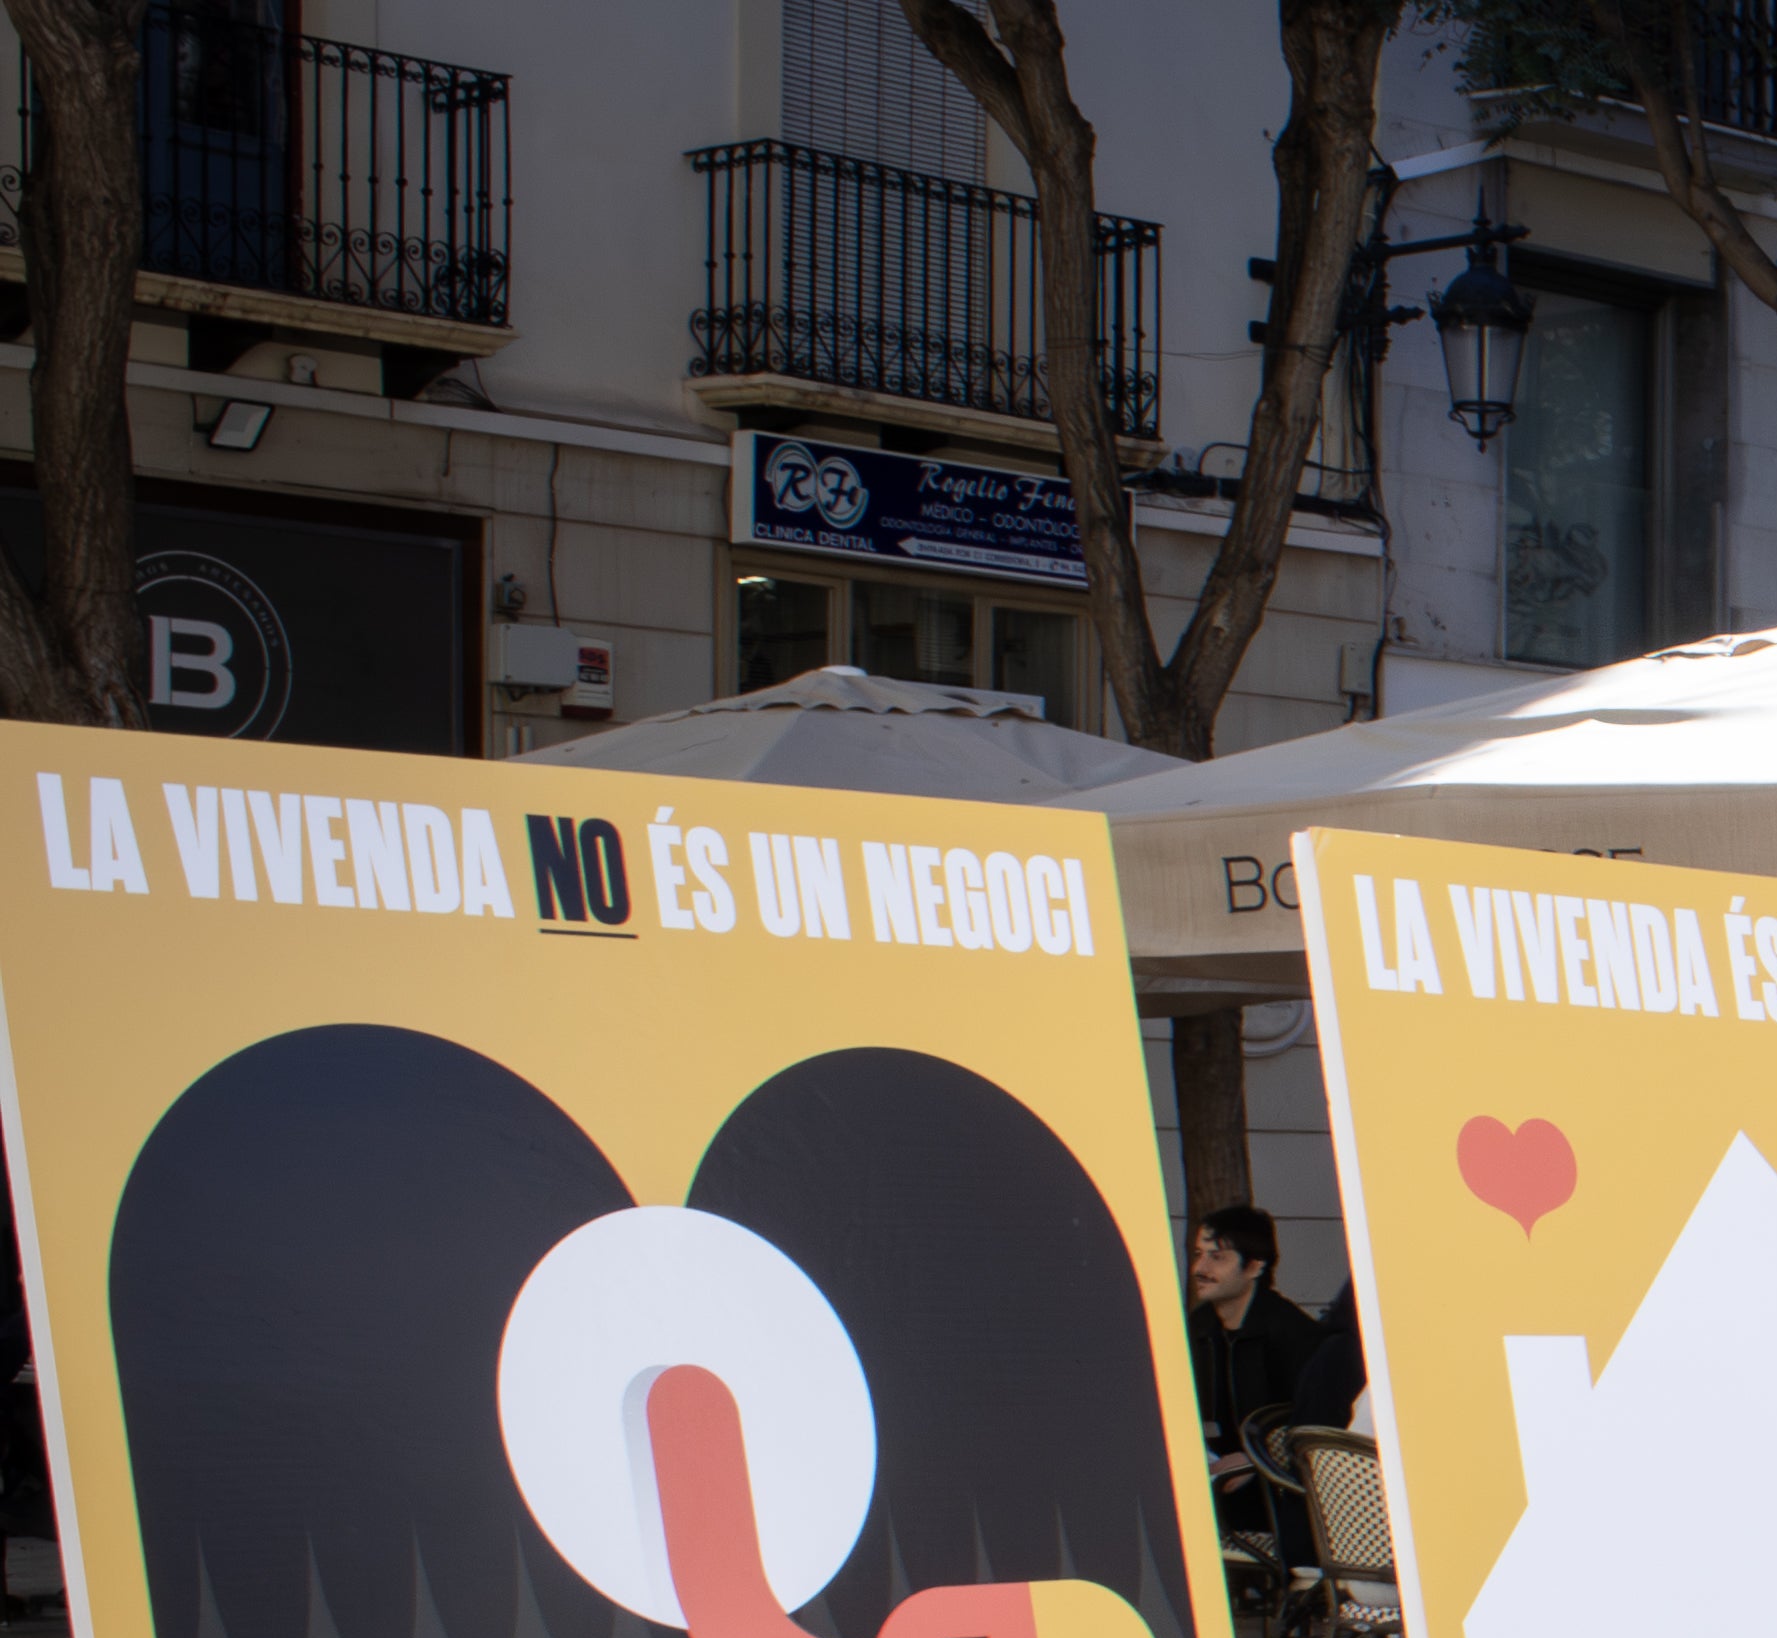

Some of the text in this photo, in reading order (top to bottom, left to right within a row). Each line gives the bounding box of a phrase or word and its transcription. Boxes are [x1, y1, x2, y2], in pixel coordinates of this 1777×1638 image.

[917, 461, 1009, 503] Rogelio
[755, 523, 877, 552] CLINICA DENTAL
[992, 511, 1081, 539] ODONTÓLOG
[149, 615, 237, 709] B
[37, 771, 150, 895] LA
[162, 782, 516, 919] VIVENDA
[525, 813, 632, 926] NO
[647, 805, 738, 934] ÉS
[748, 831, 853, 941] UN
[861, 841, 1096, 957] NEGOCI
[1352, 873, 1445, 996] LA
[1447, 883, 1721, 1019] VIVENDA
